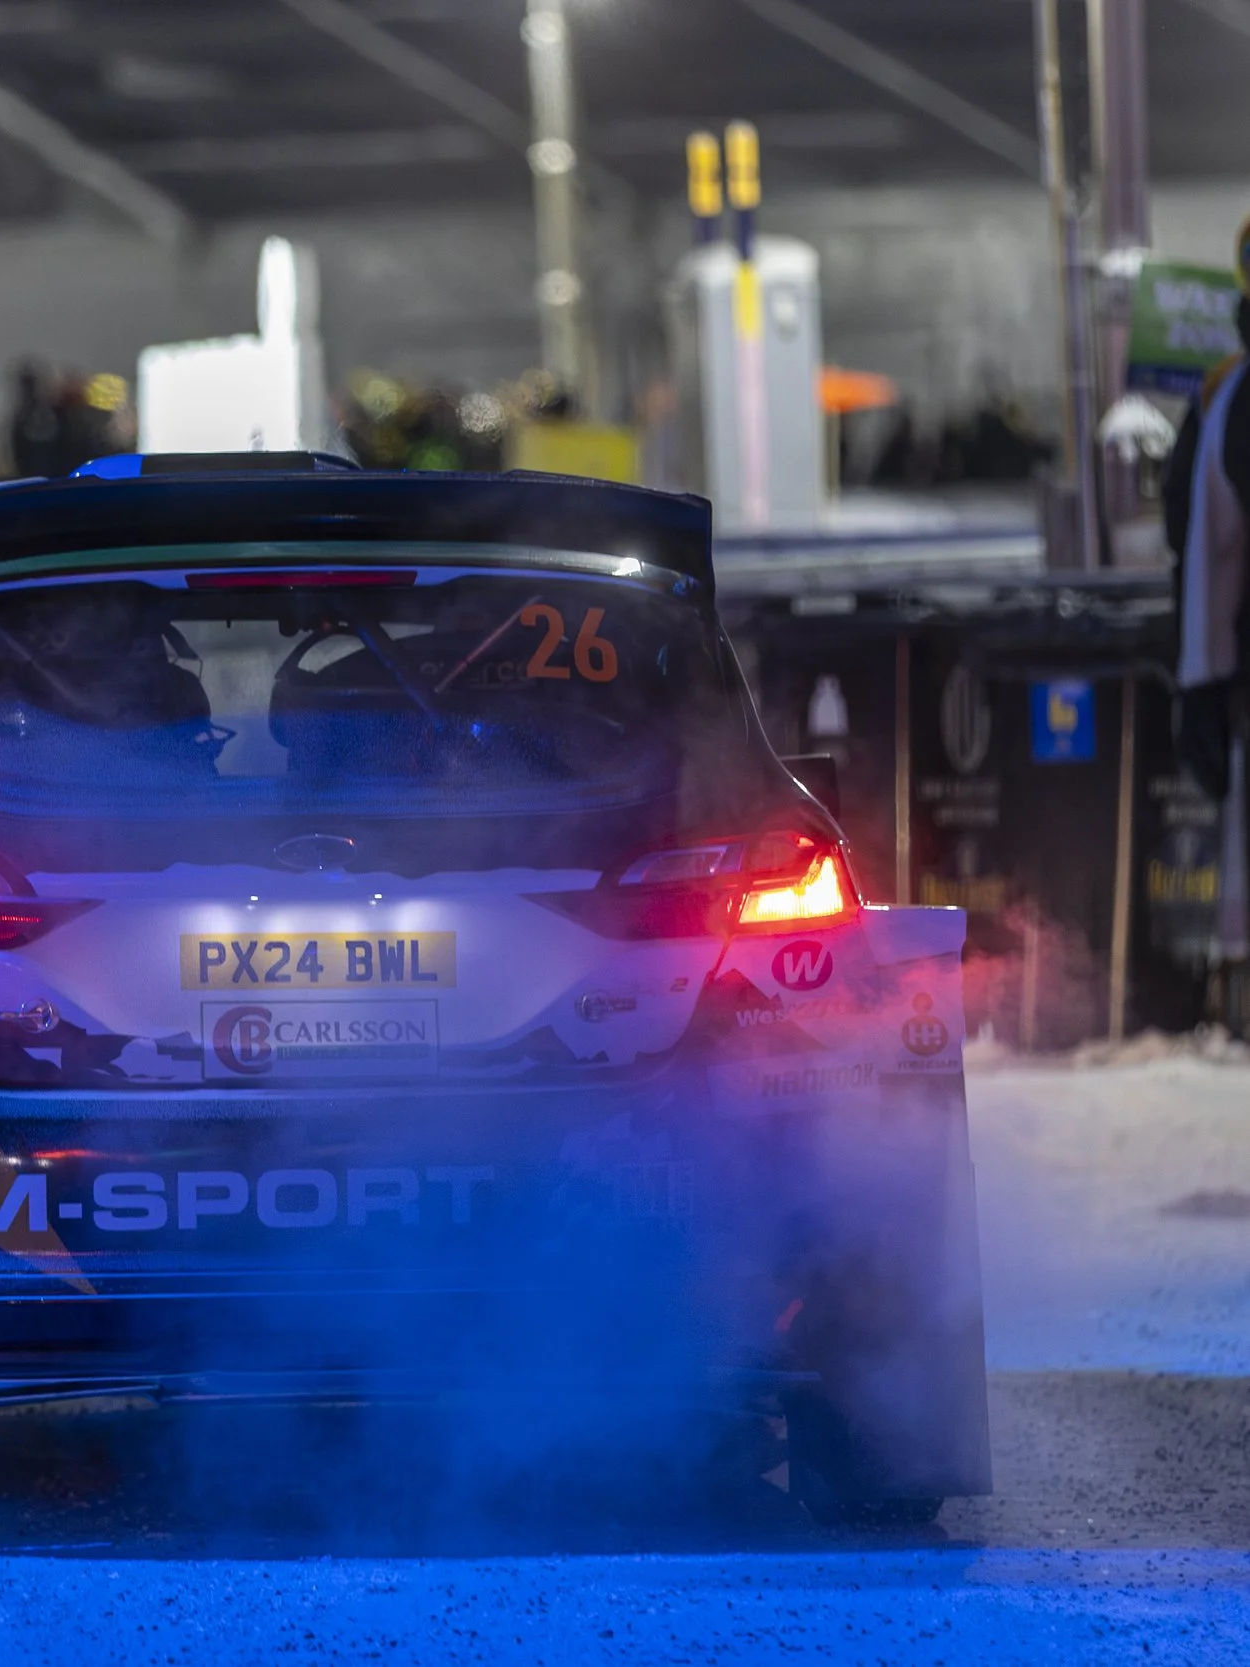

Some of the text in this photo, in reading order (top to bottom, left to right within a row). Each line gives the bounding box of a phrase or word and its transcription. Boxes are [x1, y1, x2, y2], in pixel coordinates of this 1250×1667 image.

[519, 604, 618, 682] 26
[199, 939, 438, 984] PX24 BWL
[274, 1020, 426, 1044] CARLSSON
